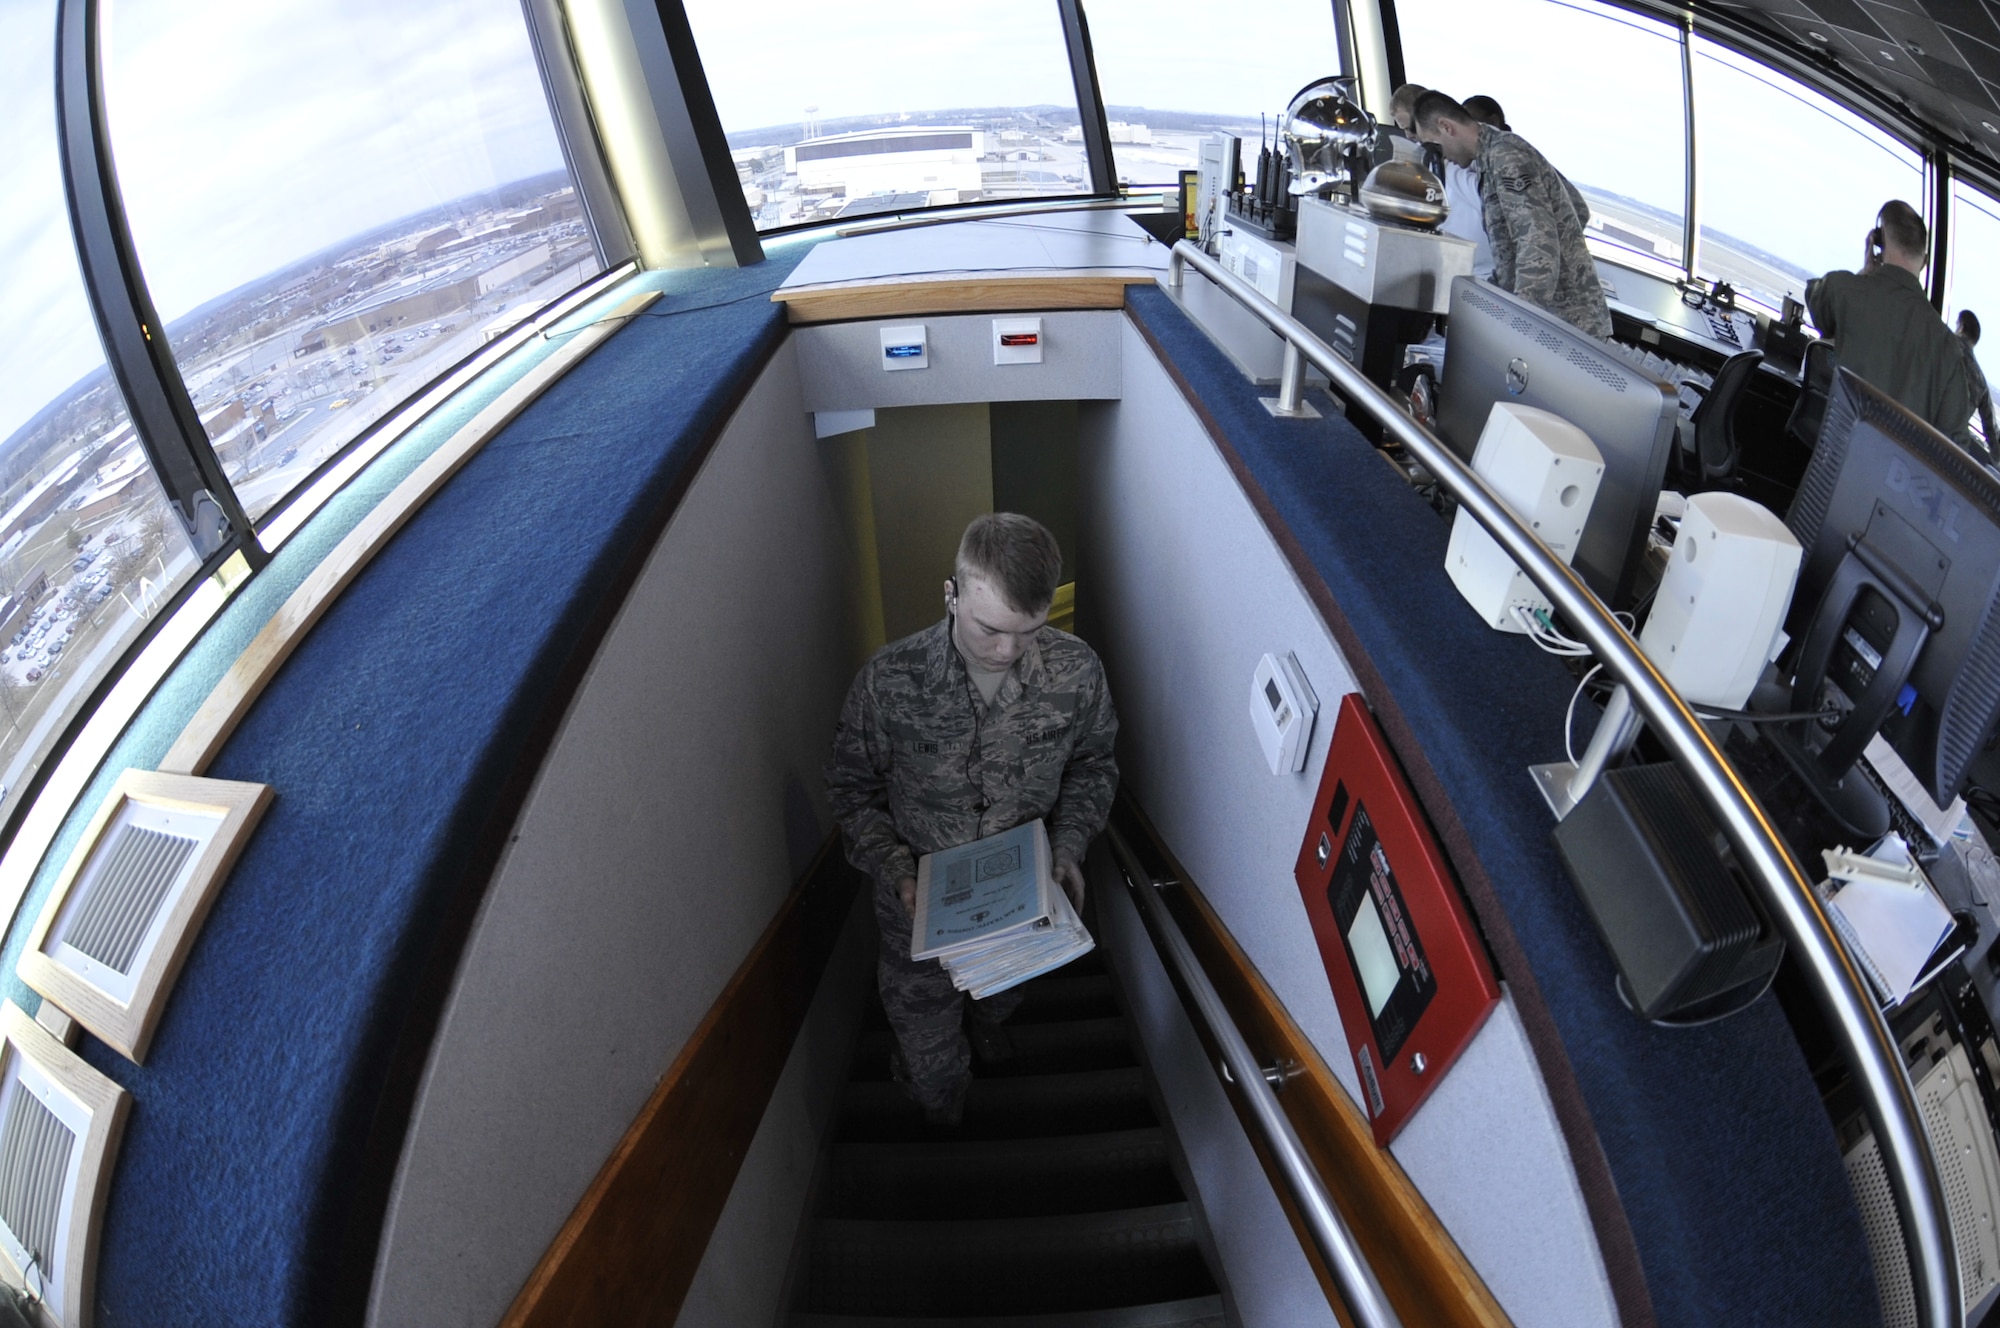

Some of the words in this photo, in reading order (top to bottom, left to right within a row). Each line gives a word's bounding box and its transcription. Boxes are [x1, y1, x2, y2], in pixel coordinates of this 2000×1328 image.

[1510, 368, 1525, 385] DELL
[1885, 455, 1960, 544] DELL
[1042, 730, 1056, 741] AIR
[912, 741, 938, 754] LEWIS
